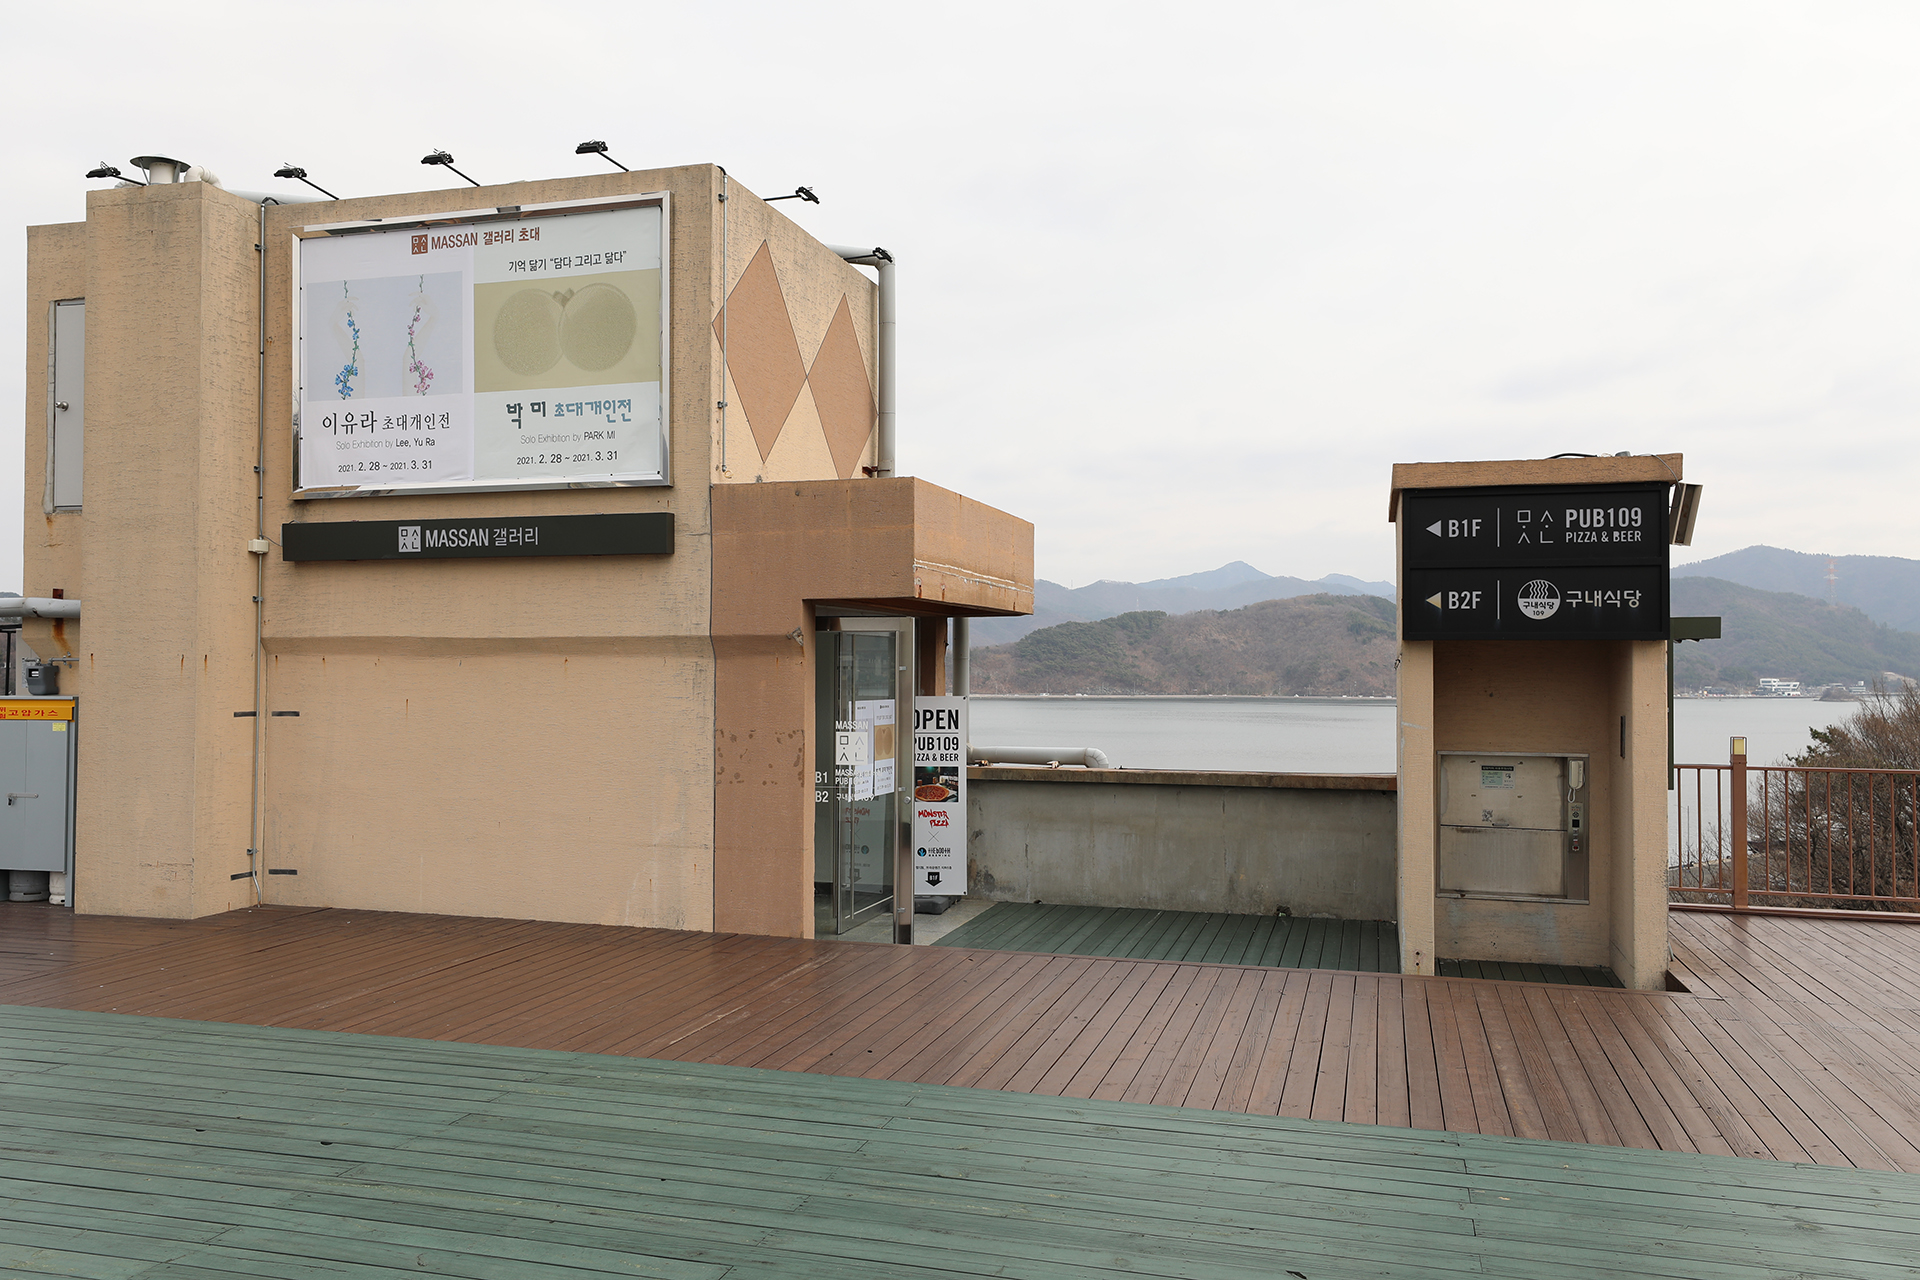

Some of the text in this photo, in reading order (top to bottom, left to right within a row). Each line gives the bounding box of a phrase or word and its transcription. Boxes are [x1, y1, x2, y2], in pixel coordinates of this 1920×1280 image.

[431, 232, 478, 250] MASSAN
[482, 229, 514, 246] 갤러리
[518, 227, 540, 242] 초대
[508, 260, 526, 273] 기억
[574, 254, 601, 268] 그리고
[506, 399, 632, 429] 박 미 초대개인전
[322, 410, 450, 435] 이유라 초대개인전
[335, 441, 350, 450] Solo
[385, 440, 394, 449] by
[395, 438, 411, 448] Lee,
[414, 437, 423, 447] Yu
[425, 437, 436, 447] Ra
[520, 434, 536, 445] Solo
[573, 432, 582, 443] by
[584, 431, 604, 441] PARK
[606, 430, 616, 440] MI
[516, 456, 537, 465] 2021.
[550, 453, 562, 463] 28
[573, 454, 593, 463] 2021.
[606, 450, 618, 460] 31
[338, 464, 357, 473] 2021.
[369, 461, 380, 471] 28
[390, 462, 409, 471] 2021.
[421, 460, 432, 469] 31
[1448, 518, 1482, 538] B1F
[1565, 507, 1642, 528] PUB109
[425, 528, 489, 548] MASSAN
[493, 527, 538, 546] 갤러리
[1565, 530, 1642, 543] PIZZA & BEER
[1448, 590, 1642, 609] B2F 구내식당
[1523, 601, 1555, 610] 구내식당
[835, 720, 869, 730] MASSAN
[931, 753, 938, 761] &
[940, 753, 959, 762] BEER
[815, 771, 828, 783] B1
[815, 790, 829, 803] B2
